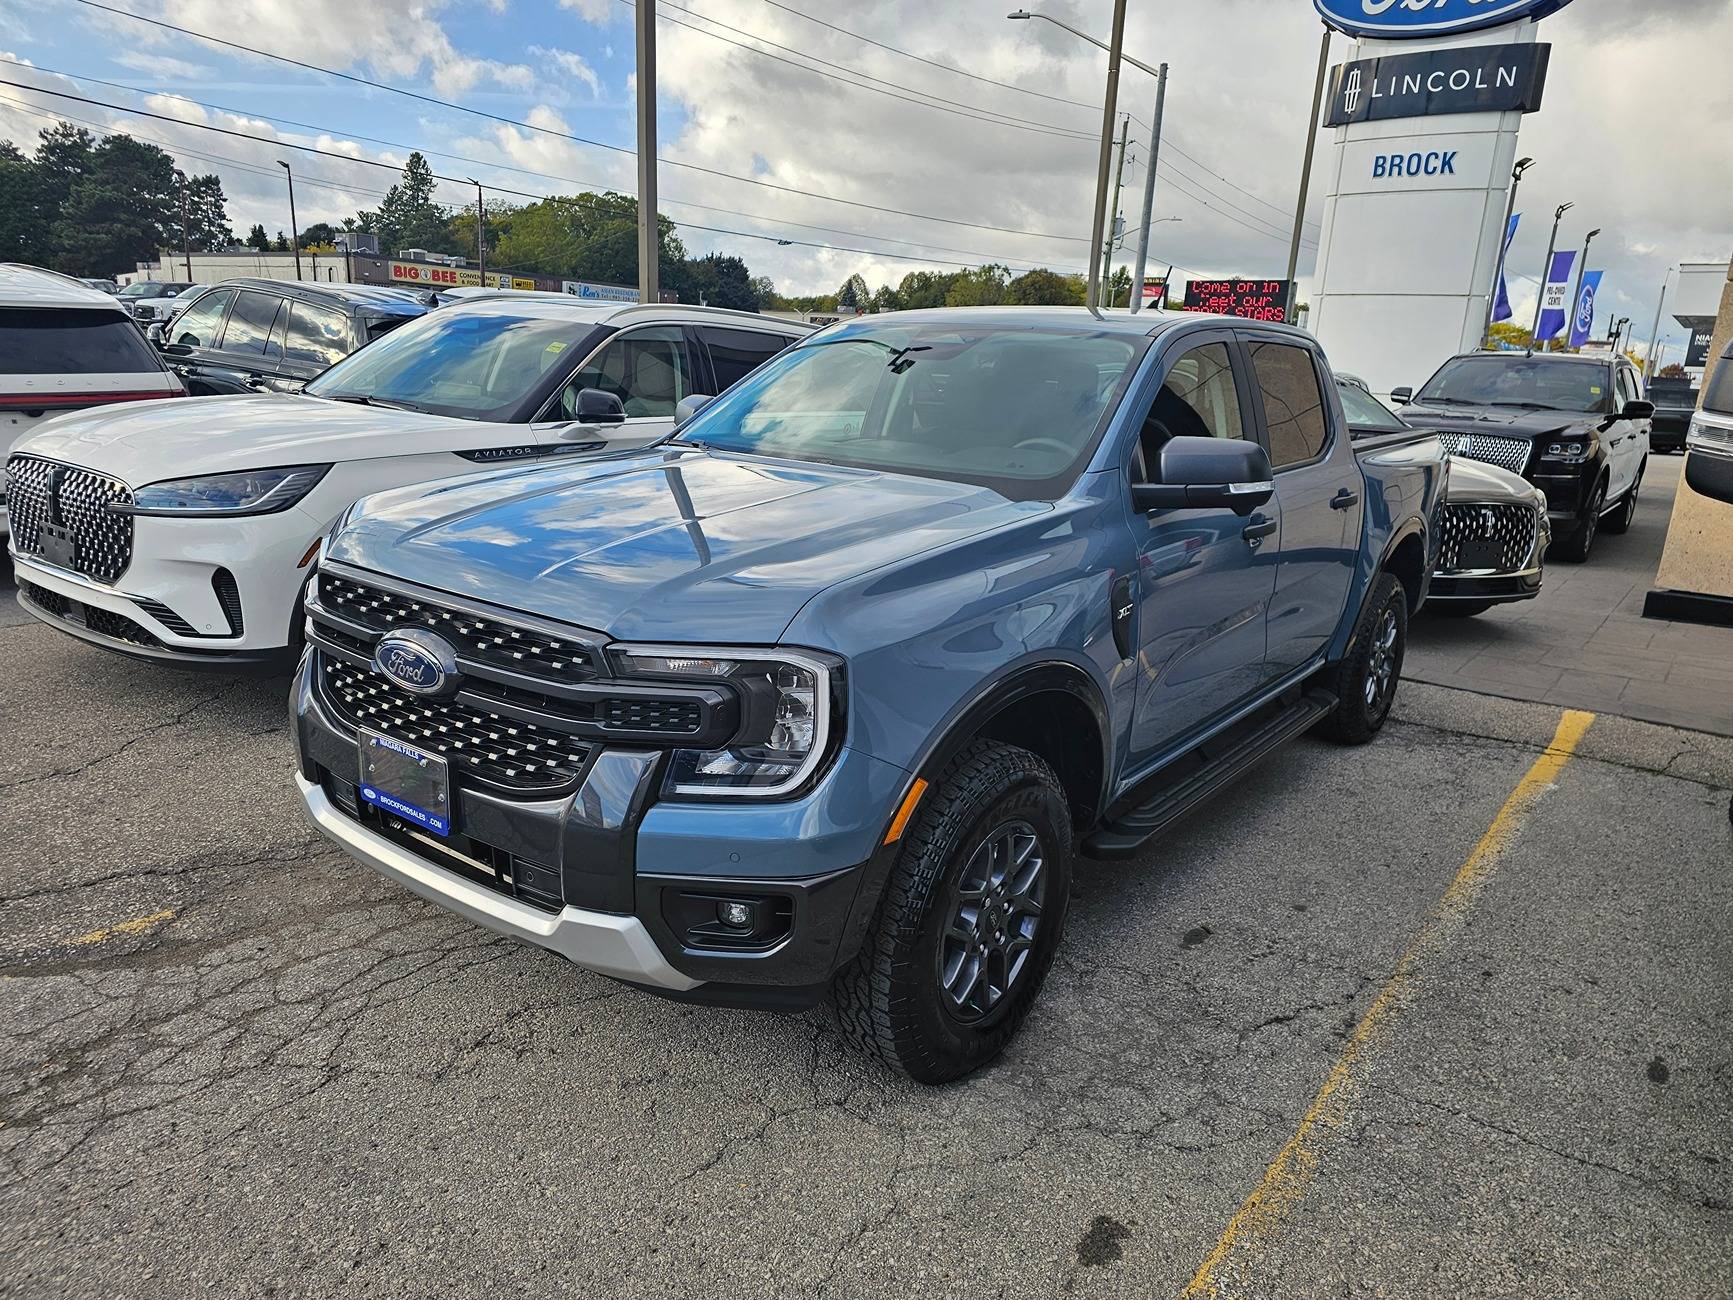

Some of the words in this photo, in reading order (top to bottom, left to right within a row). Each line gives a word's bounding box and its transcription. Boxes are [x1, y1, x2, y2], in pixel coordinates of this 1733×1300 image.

[1371, 66, 1518, 98] LINCOLN
[1371, 150, 1458, 178] BROCK
[393, 264, 419, 280] BIG
[431, 268, 457, 284] BEE
[459, 272, 496, 282] CONVENNCE
[1262, 280, 1280, 293] in
[1243, 296, 1273, 307] our
[1580, 295, 1593, 322] Ford
[1235, 306, 1284, 321] STARS
[474, 447, 532, 459] AVIATOR
[1117, 603, 1134, 620] XLT
[388, 649, 424, 684] Ford
[380, 737, 403, 753] NIAGARA
[402, 747, 420, 760] FALLS
